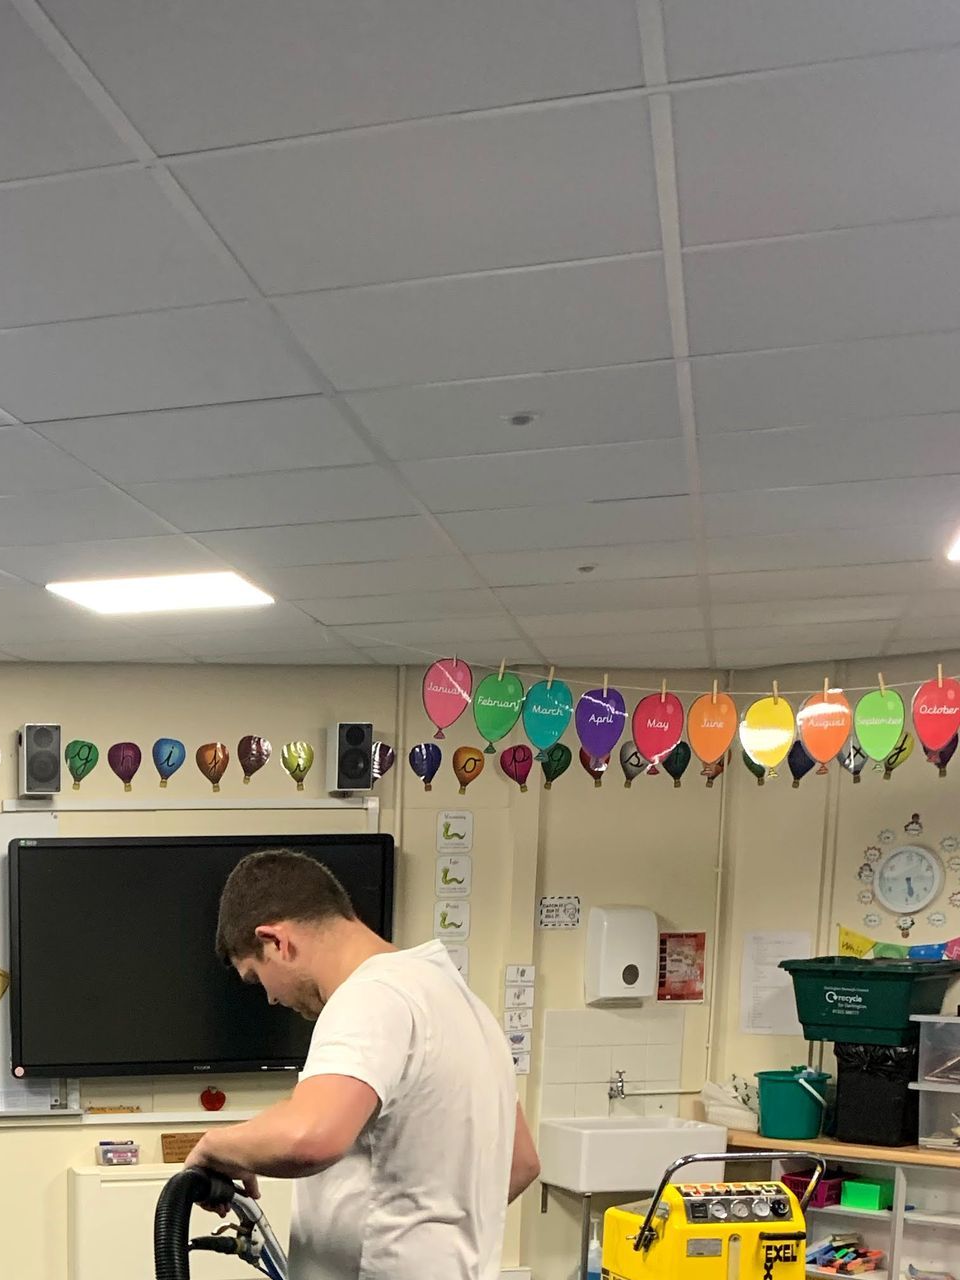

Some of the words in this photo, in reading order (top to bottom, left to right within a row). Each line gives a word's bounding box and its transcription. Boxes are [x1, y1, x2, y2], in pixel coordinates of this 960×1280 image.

[427, 681, 470, 698] January
[477, 694, 522, 712] February
[919, 704, 960, 715] October
[531, 704, 564, 717] March
[589, 713, 614, 726] April
[646, 718, 670, 731] May
[700, 718, 725, 729] June
[807, 717, 846, 730] August
[855, 715, 903, 728] September
[71, 743, 94, 778] g
[159, 746, 176, 769] i
[510, 746, 530, 781] p
[838, 994, 863, 1004] recycle
